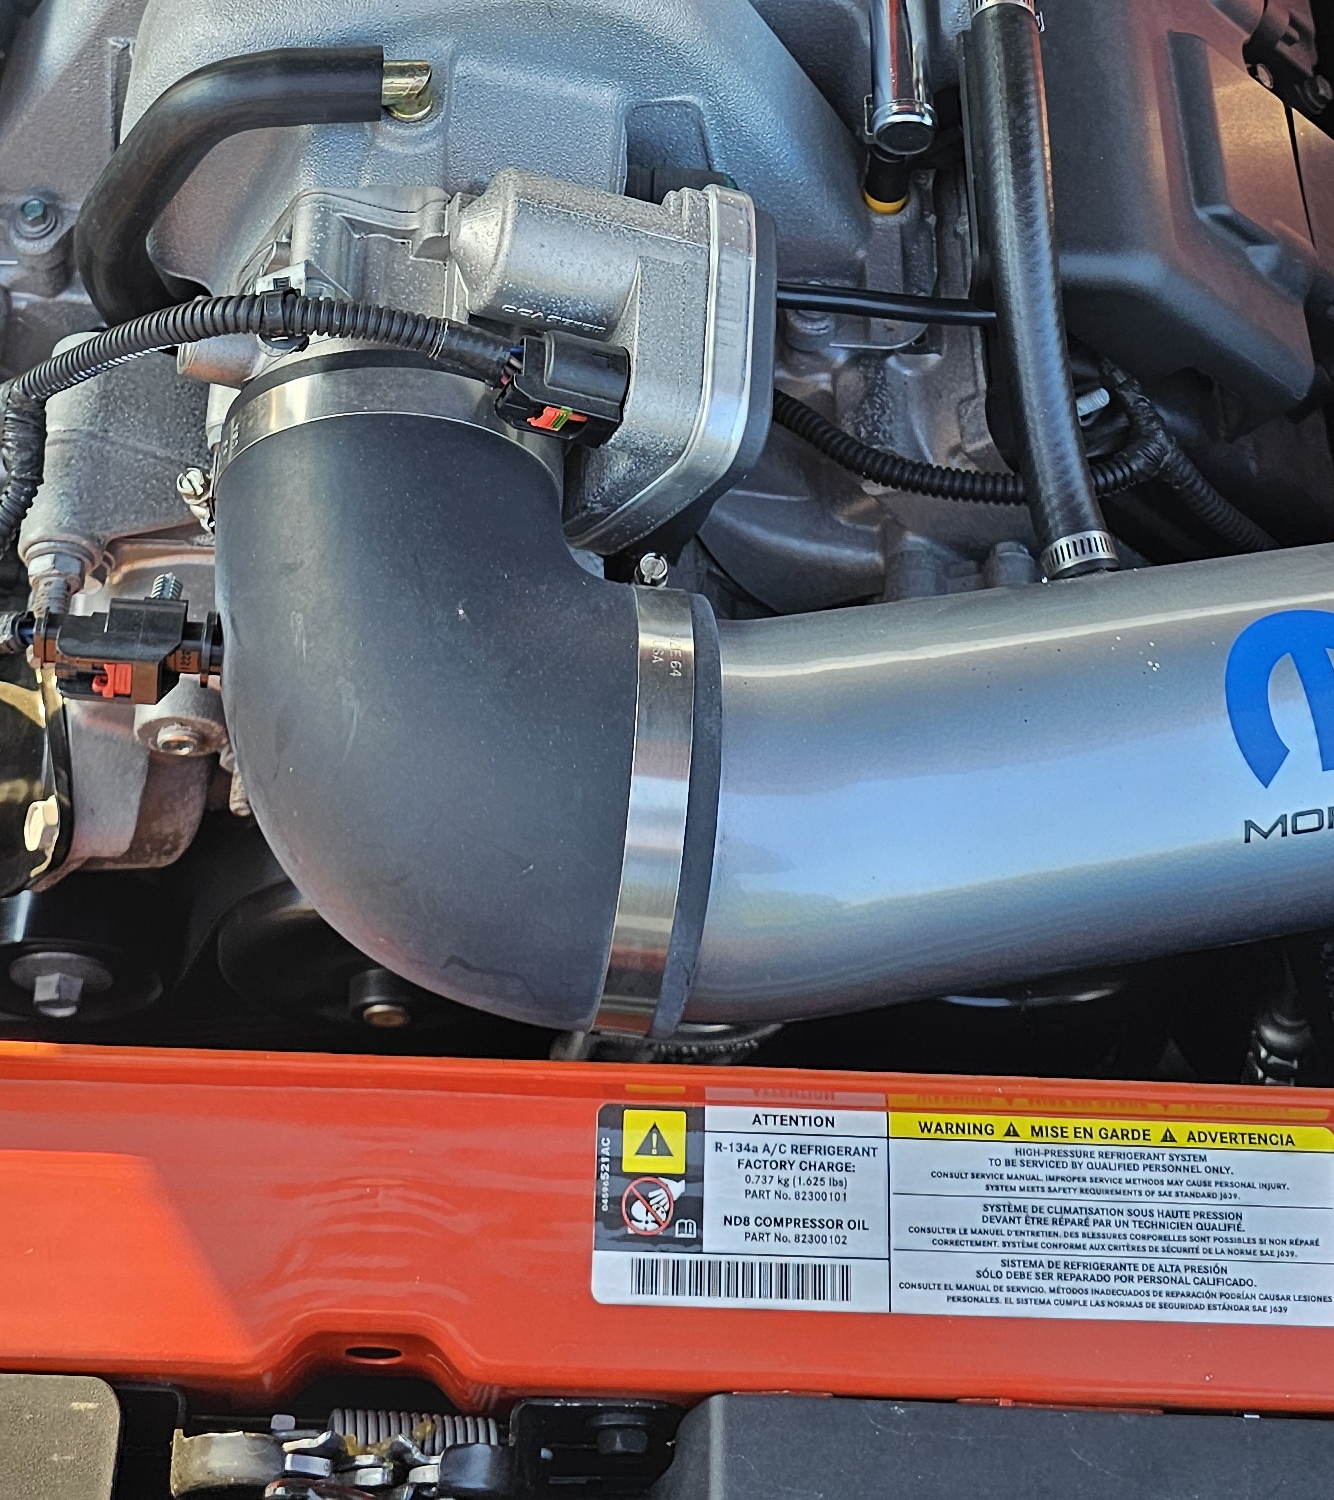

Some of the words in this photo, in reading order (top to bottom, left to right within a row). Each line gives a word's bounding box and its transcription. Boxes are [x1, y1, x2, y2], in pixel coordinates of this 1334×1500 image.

[752, 1114, 834, 1128] ATTENTION
[918, 1121, 994, 1136] WARNING
[1031, 1125, 1069, 1138] MISE
[1073, 1126, 1093, 1139] EN
[1099, 1127, 1151, 1141] GARDE
[1187, 1130, 1295, 1146] ADVERTENCIA
[715, 1142, 758, 1153] R-134a
[762, 1143, 786, 1156] A/C
[791, 1144, 878, 1157] REFRIGERANT
[1015, 1148, 1095, 1158] HIGH-PRESSURE
[1098, 1151, 1166, 1161] REFRIGERANT
[1169, 1153, 1207, 1162] SYSTEM
[737, 1158, 795, 1170] FACTORY
[799, 1160, 855, 1172] CHARGE:
[988, 1158, 1001, 1166] TO
[1005, 1158, 1016, 1167] BE
[1019, 1159, 1068, 1169] SERVICED
[1071, 1161, 1083, 1170] BY
[1086, 1161, 1139, 1171] QUALIFIED
[1143, 1164, 1202, 1173] PERSONNEL
[1204, 1165, 1233, 1174] ONLY.
[745, 1175, 774, 1185] 0.737
[778, 1176, 789, 1187] kg
[793, 1176, 825, 1188] (1.625
[829, 1177, 847, 1189] lbs)
[931, 1170, 968, 1179] CONSULT
[971, 1172, 1004, 1180] SERVICE
[1007, 1173, 1043, 1181] MANUAL.
[1089, 1176, 1122, 1184] SERVICE
[1125, 1178, 1164, 1186] METHODS
[1185, 1179, 1212, 1187] CAUSE
[1215, 1180, 1256, 1189] PERSONAL
[1259, 1182, 1289, 1191] INJURY.
[745, 1189, 771, 1200] PART
[774, 1190, 791, 1200] No.
[794, 1191, 846, 1202] 82300101
[985, 1184, 1016, 1192] SYSTEM
[1047, 1186, 1077, 1194] SAFETY
[1079, 1187, 1142, 1196] REQUIREMENTS
[1175, 1191, 1217, 1199] STANDARD
[1219, 1192, 1240, 1200] J639.
[983, 1202, 1028, 1213] SYSTÈME
[1031, 1205, 1044, 1214] DE
[1047, 1206, 1123, 1217] CLIMATISATION
[1127, 1208, 1154, 1218] SOUS
[1157, 1209, 1190, 1219] HAUTE
[1193, 1211, 1242, 1220] PRESSION
[723, 1215, 750, 1226] ND8
[754, 1216, 843, 1230] COMPRESSOR
[847, 1219, 869, 1230] OIL
[981, 1215, 1021, 1224] DEVANT
[1025, 1215, 1048, 1225] ÊTRE
[1051, 1216, 1089, 1227] RÉPARÉ
[1093, 1219, 1111, 1227] PAR
[1115, 1219, 1129, 1228] UN
[1131, 1219, 1192, 1230] TECHNICIEN
[1195, 1221, 1245, 1232] QUALIFIÉ.
[745, 1231, 771, 1242] PART
[774, 1232, 790, 1243] No.
[794, 1234, 847, 1245] 82300102
[1001, 1259, 1045, 1269] SISTEMA
[1047, 1260, 1060, 1269] DE
[1063, 1261, 1139, 1272] REFRIGERANTE
[1141, 1263, 1155, 1272] DE
[1157, 1264, 1181, 1273] ALTA
[1184, 1264, 1227, 1274] PRESIÓN
[976, 1268, 1003, 1279] SÓLO
[1006, 1270, 1032, 1280] DEBE
[1035, 1272, 1053, 1280] SER
[1057, 1272, 1111, 1283] REPARADO
[1114, 1274, 1134, 1283] POR
[1137, 1275, 1191, 1285] PERSONAL
[1193, 1276, 1257, 1287] CALIFICADO.
